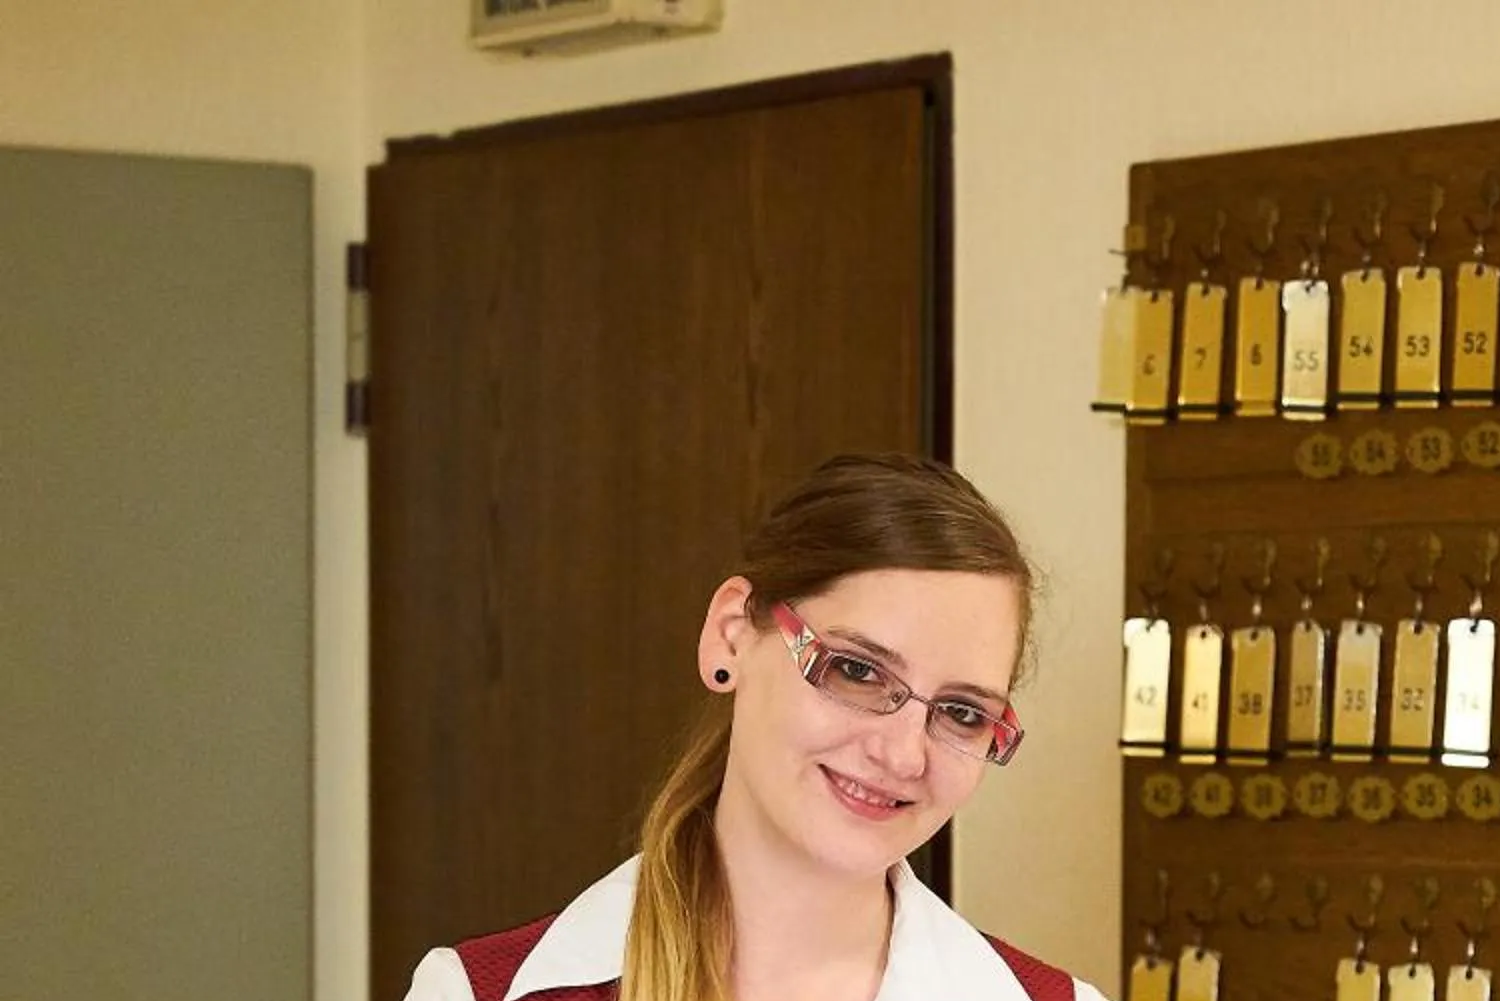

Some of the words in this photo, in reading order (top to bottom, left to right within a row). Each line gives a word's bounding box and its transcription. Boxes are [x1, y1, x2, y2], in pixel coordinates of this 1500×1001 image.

[1349, 335, 1374, 358] 54
[1405, 334, 1431, 357] 53
[1463, 332, 1488, 355] 52
[1294, 350, 1320, 372] 55
